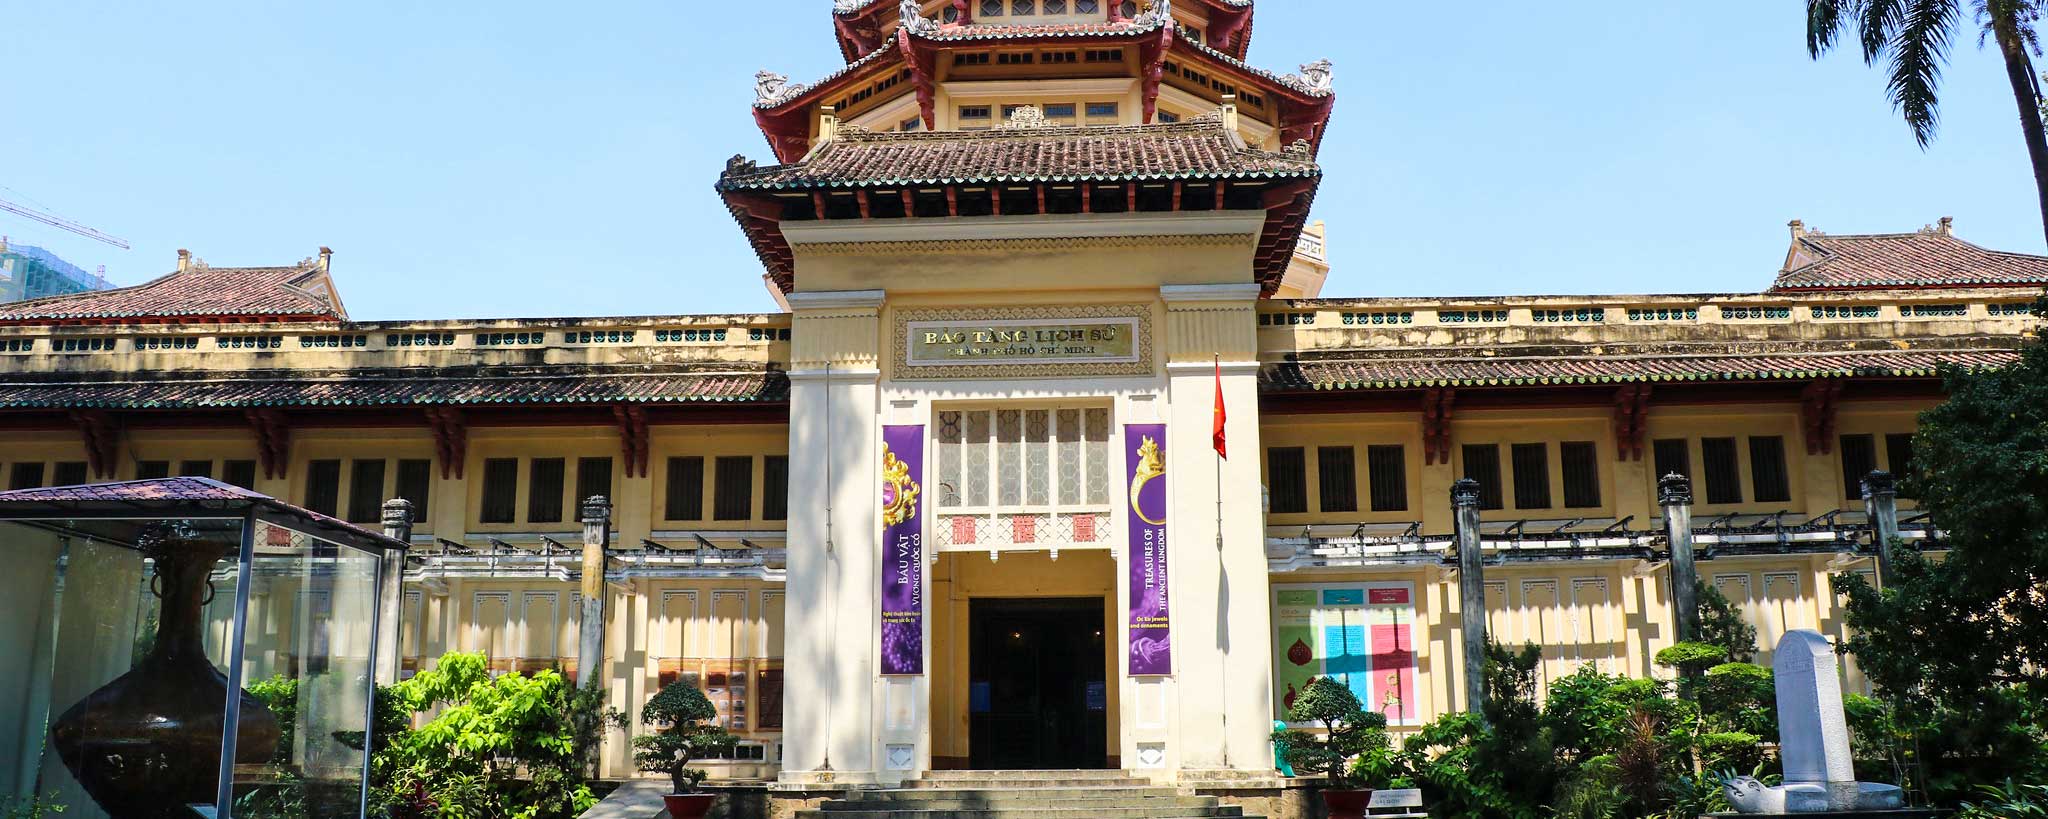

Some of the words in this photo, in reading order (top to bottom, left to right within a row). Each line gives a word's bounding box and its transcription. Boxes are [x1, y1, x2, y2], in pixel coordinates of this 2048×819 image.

[924, 327, 966, 344] BẢO
[972, 328, 1028, 343] TÀNG
[1035, 329, 1084, 346] LỊCH
[1064, 346, 1095, 354] MINH
[1144, 528, 1153, 540] OF
[897, 534, 911, 557] VẬT
[897, 560, 909, 584] BÁU
[1144, 541, 1153, 589] TREASURES
[1158, 564, 1167, 596] ANCIENT
[1159, 596, 1167, 611] THE
